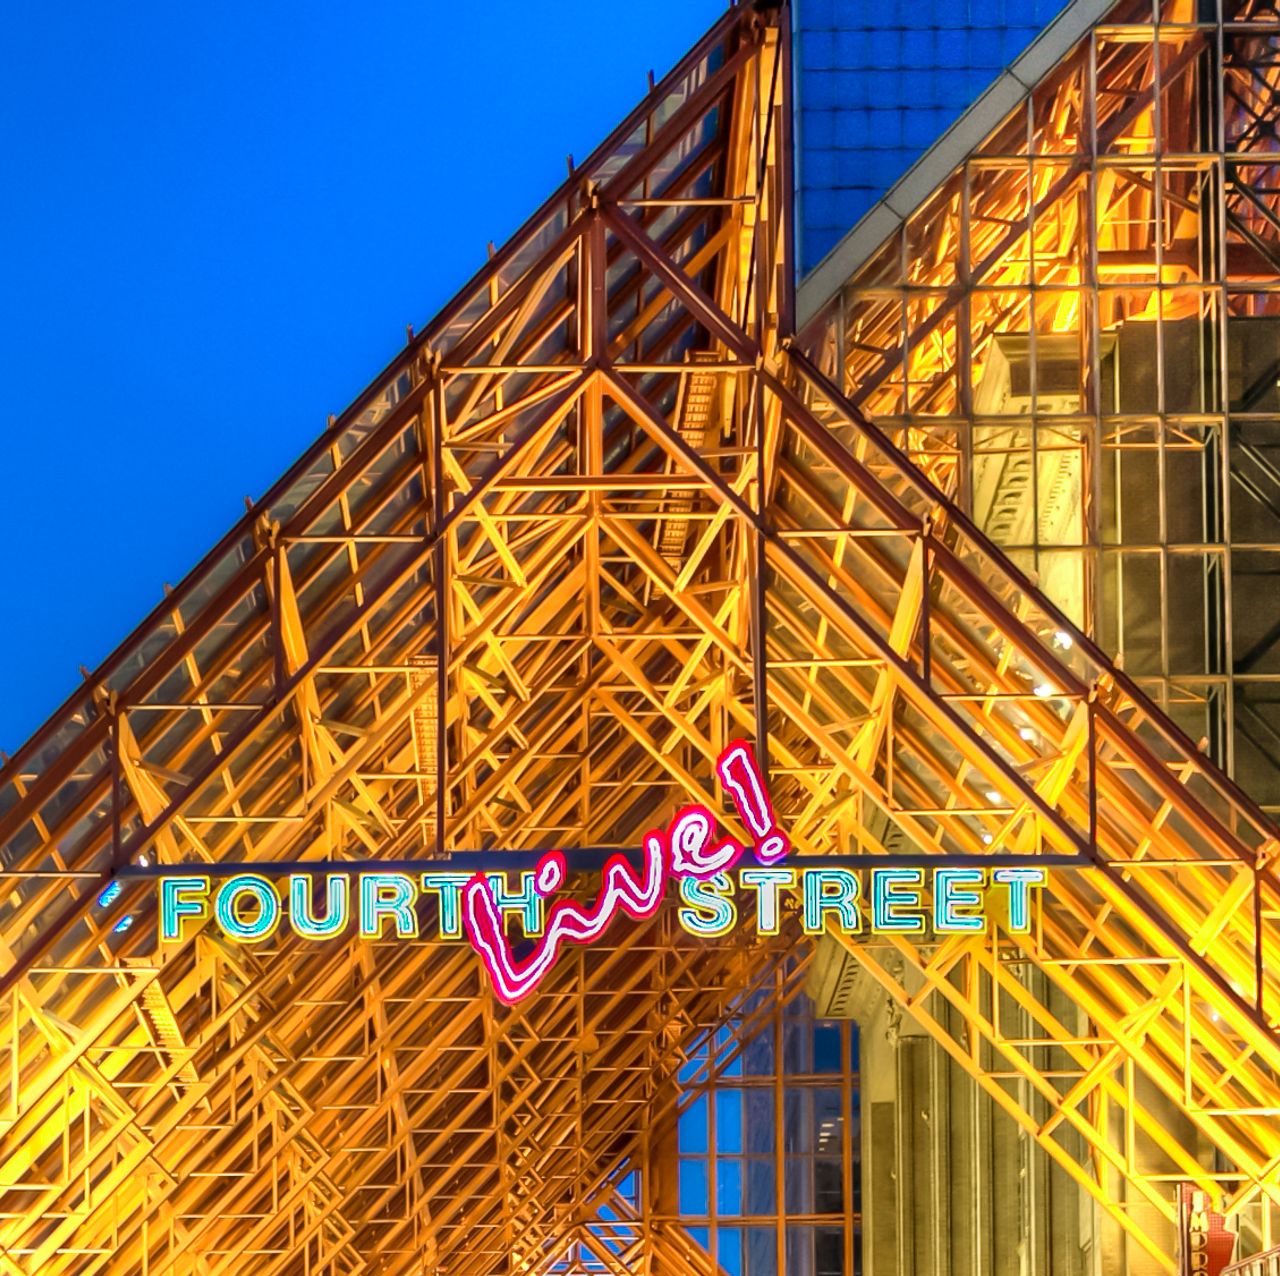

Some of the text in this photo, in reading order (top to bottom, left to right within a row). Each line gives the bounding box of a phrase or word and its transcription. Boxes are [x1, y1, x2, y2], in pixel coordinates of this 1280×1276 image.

[159, 868, 1048, 944] FOURTH STREET
[463, 738, 791, 1006] Live!
